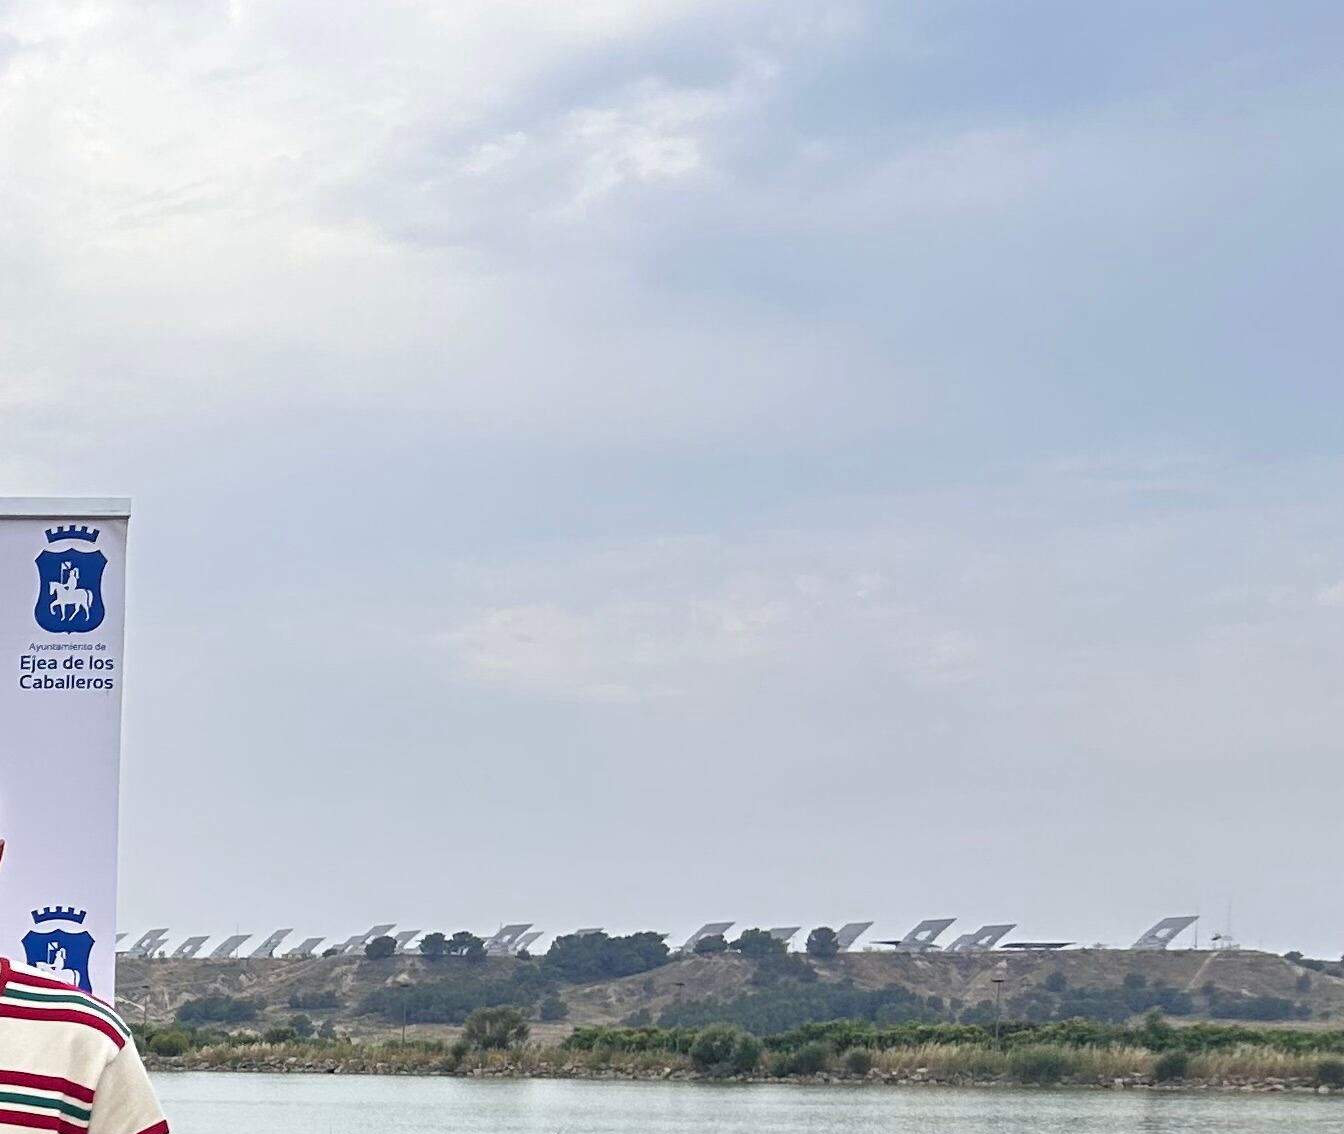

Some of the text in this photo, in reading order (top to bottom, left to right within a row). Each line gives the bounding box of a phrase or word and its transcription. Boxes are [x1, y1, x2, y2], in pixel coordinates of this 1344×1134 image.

[29, 643, 93, 652] Ayuntamiento
[21, 656, 113, 673] Ejea de los
[20, 675, 113, 689] Caballeros
